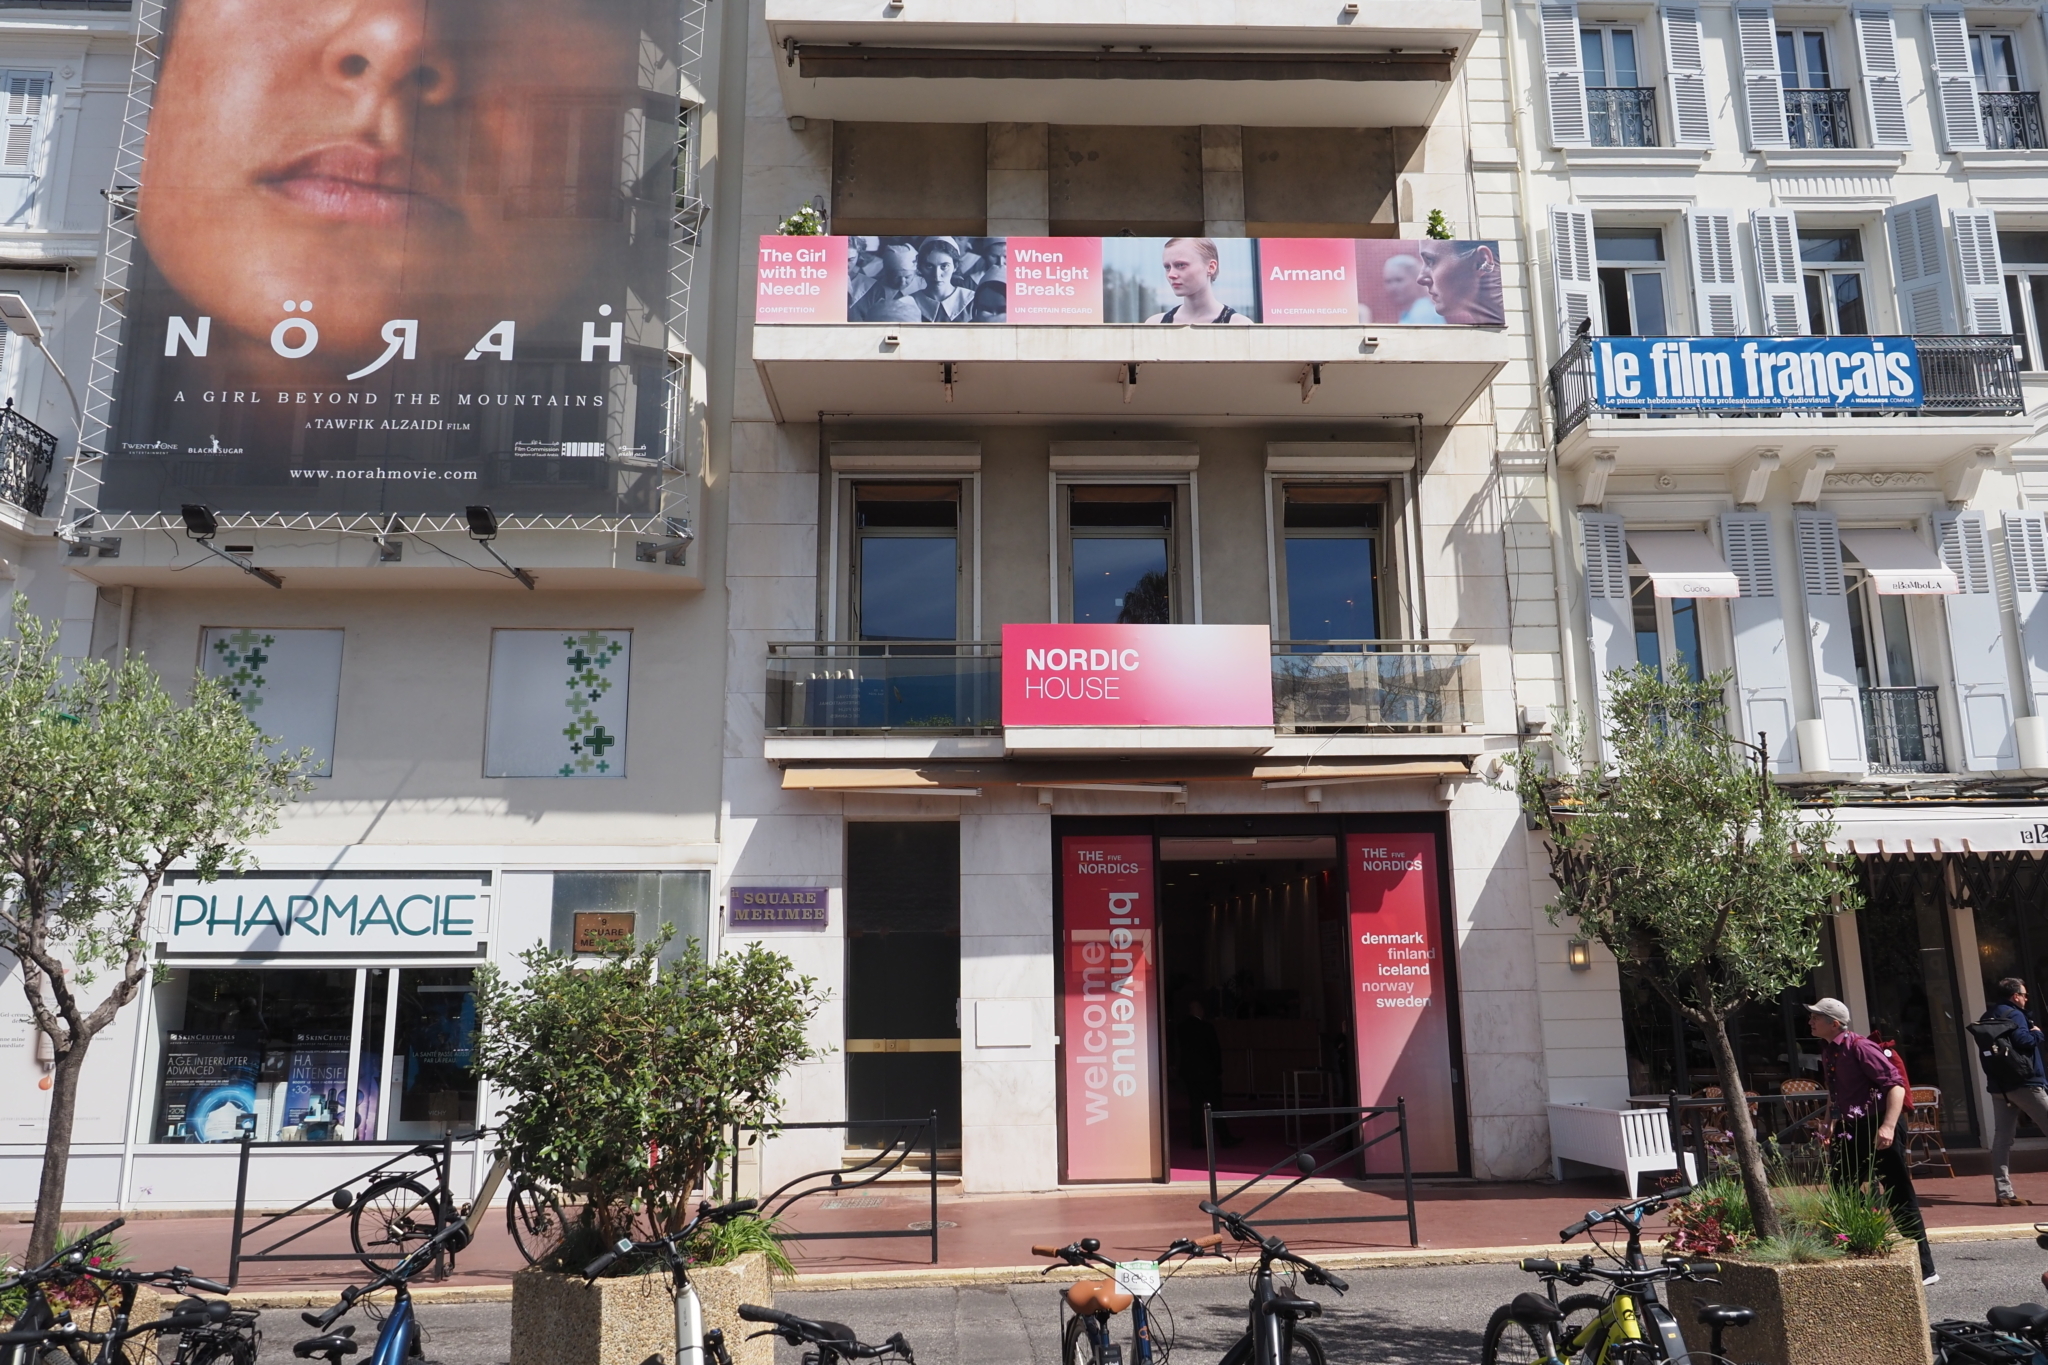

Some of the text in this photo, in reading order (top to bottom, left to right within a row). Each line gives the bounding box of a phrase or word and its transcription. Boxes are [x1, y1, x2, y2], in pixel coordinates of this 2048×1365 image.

[760, 249, 826, 262] The Girl
[1014, 249, 1063, 263] When
[760, 265, 827, 279] with the
[1014, 266, 1089, 282] the Light
[1269, 266, 1345, 281] Armand
[760, 282, 820, 296] Needle
[1014, 282, 1075, 296] Breaks
[759, 306, 815, 314] COMPETITION
[1600, 342, 1915, 403] le film français
[174, 391, 604, 407] A GIRL BEYOND THE MOUNTAINS
[1616, 398, 1646, 406] premier
[1647, 397, 1701, 405] hebdomadaire
[1702, 397, 1716, 405] des
[1716, 397, 1771, 406] professionnels
[1783, 396, 1831, 404] l'audiovisuel
[315, 419, 374, 429] TAWFIK
[380, 419, 443, 430] ALZAIDI
[447, 423, 471, 431] FILM
[290, 467, 477, 479] www.norahmovie.com
[1683, 584, 1711, 593] Cucina
[1026, 648, 1140, 671] NORDIC
[1026, 677, 1120, 699] HOUSE
[1078, 850, 1104, 861] THE
[1362, 848, 1388, 858] THE
[1078, 863, 1139, 874] NORDICS
[1363, 860, 1423, 871] NORDICS
[743, 892, 816, 904] SQUARE
[174, 894, 477, 936] PHARMACIE
[735, 909, 825, 920] MERIMEE
[601, 918, 607, 926] 9
[1361, 932, 1424, 944] denmark
[1387, 947, 1436, 960] finland
[1378, 963, 1430, 976] iceland
[1362, 981, 1415, 994] norway
[1108, 892, 1139, 1098] bienvenue
[1376, 995, 1432, 1008] sweden
[1076, 941, 1109, 1126] welcome
[194, 1056, 248, 1066] INTERRUPTER
[166, 1066, 215, 1075] ADVANCED
[292, 1067, 347, 1080] INTENSIFI
